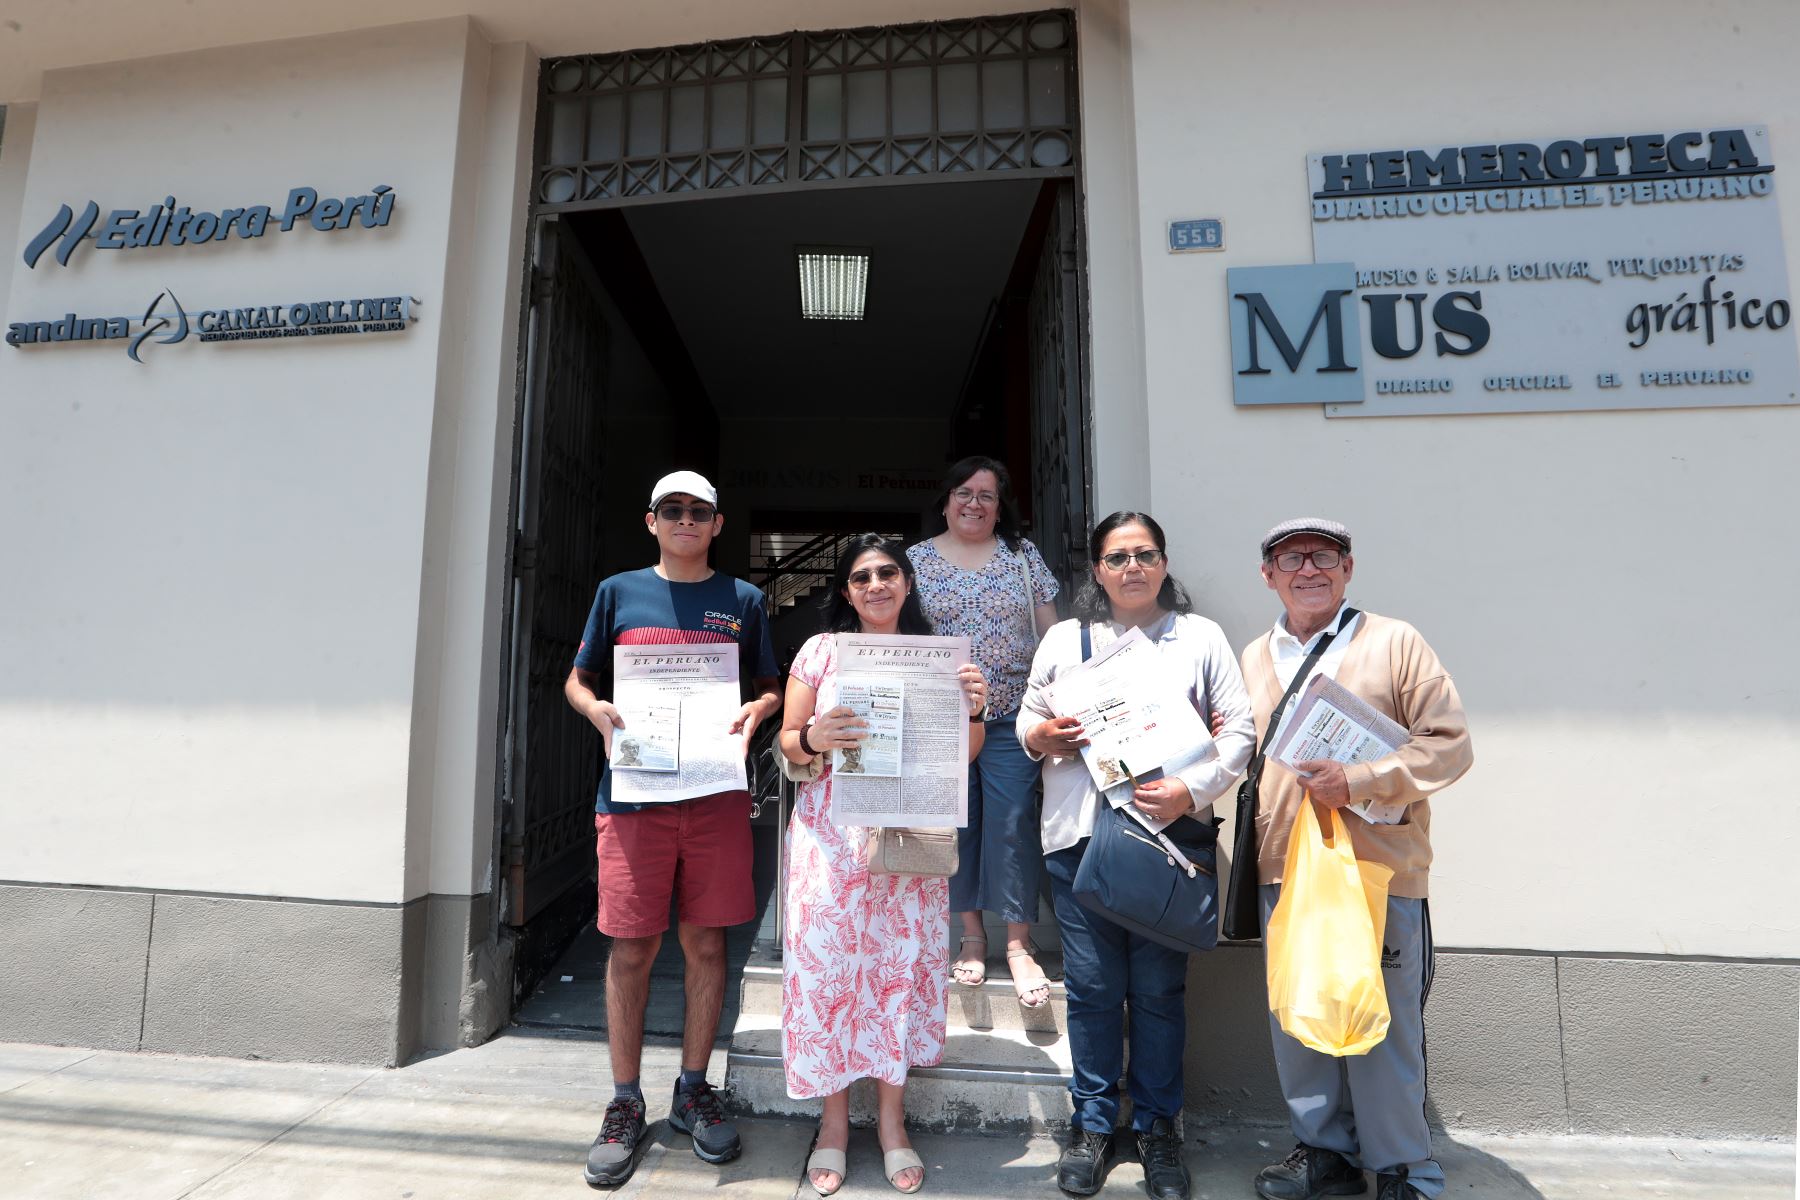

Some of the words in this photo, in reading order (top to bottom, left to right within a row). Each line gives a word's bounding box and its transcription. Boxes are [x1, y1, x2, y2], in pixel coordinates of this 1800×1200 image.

[1322, 129, 1759, 192] HEMEROTECA
[1313, 194, 1430, 221] DIARIO
[1433, 188, 1557, 214] OFICIAL
[1560, 184, 1605, 207] EL
[1608, 174, 1776, 204] PERUANO
[95, 195, 272, 249] Editora
[280, 184, 396, 232] Perú
[1177, 228, 1216, 244] 556
[1447, 264, 1500, 284] SALA
[1508, 257, 1602, 284] BOLIVAR
[198, 305, 286, 333] CANAL
[289, 297, 403, 326] ONLINE
[1625, 275, 1791, 348] gráfico
[5, 313, 130, 347] andina
[1376, 377, 1455, 395] DIARIO
[1483, 374, 1572, 392] OFICIAL
[1598, 372, 1622, 388] EL
[1639, 368, 1754, 387] PERUANO
[857, 474, 874, 488] El
[704, 611, 742, 625] ORACLE
[632, 657, 650, 666] EL
[656, 656, 721, 665] PERUANO
[882, 649, 952, 659] PERUANO
